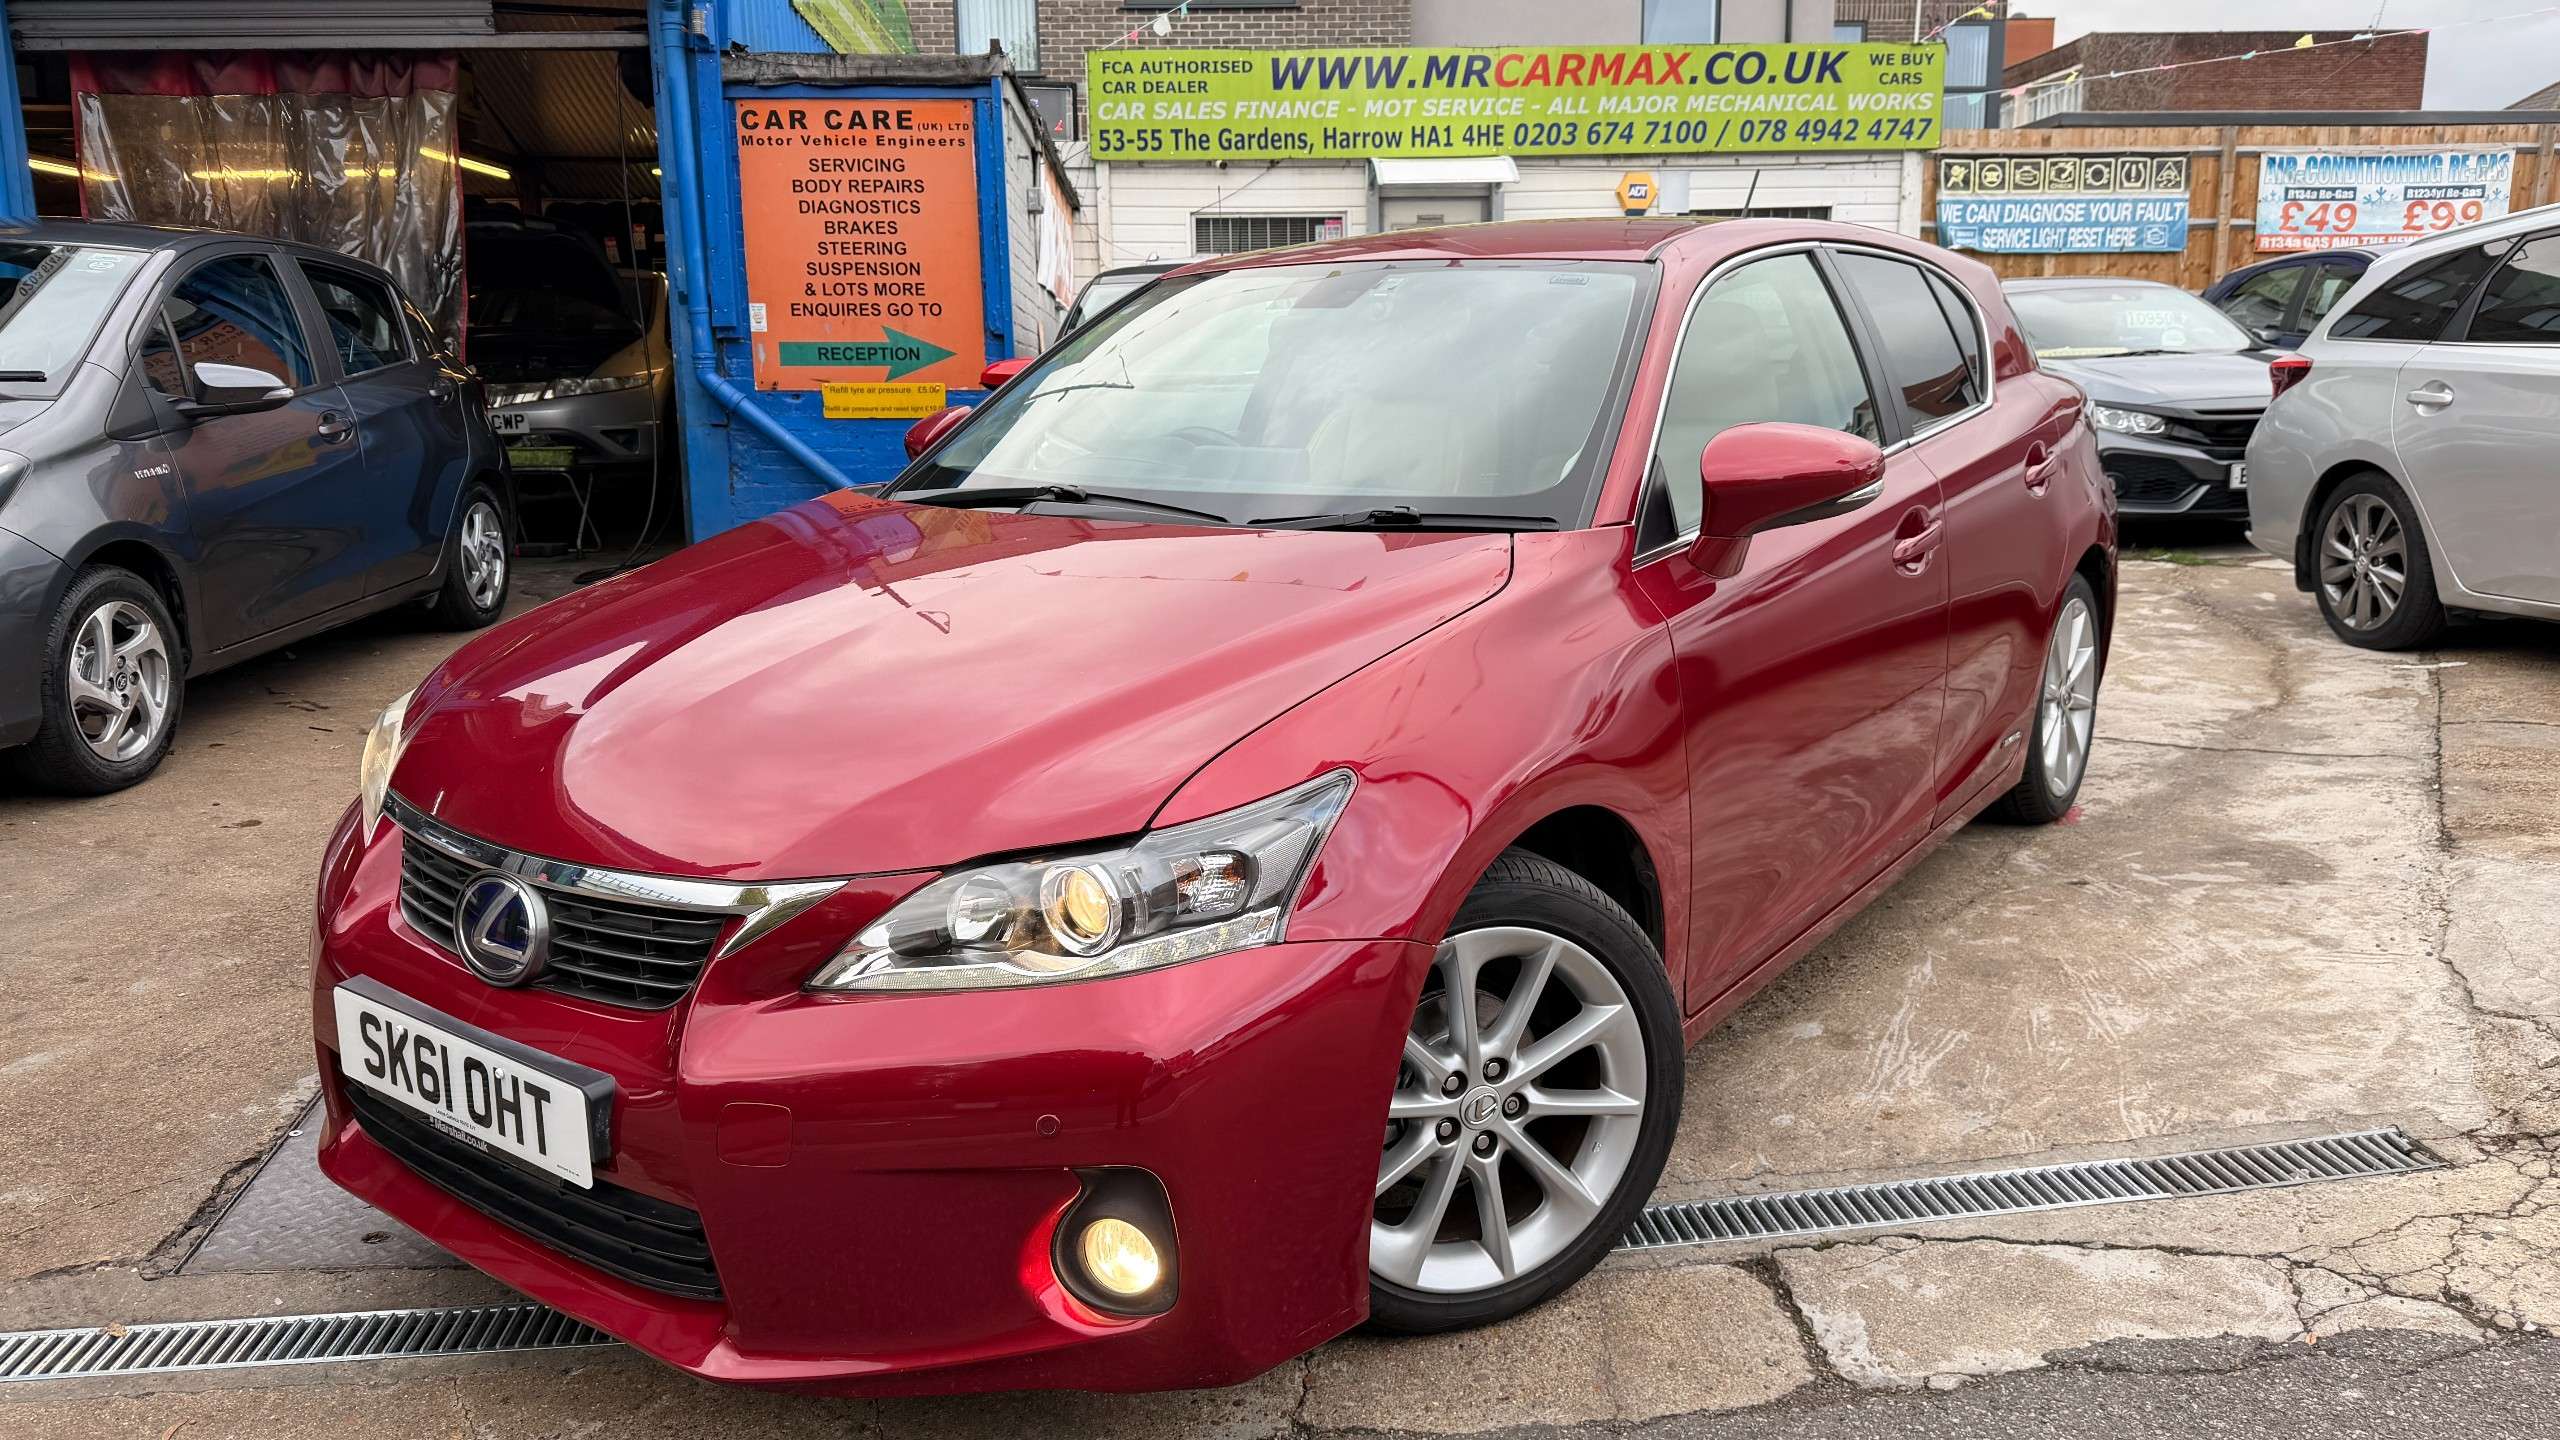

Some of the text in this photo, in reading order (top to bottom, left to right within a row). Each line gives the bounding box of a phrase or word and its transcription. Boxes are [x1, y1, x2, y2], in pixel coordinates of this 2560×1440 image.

[1870, 52, 1935, 66] WE BUY
[1102, 59, 1253, 75] FCA AUTHORISED
[1271, 50, 1849, 91] WWW.MRCARMAX.CO.UK
[1879, 72, 1922, 85] CARS
[1102, 80, 1209, 95] CAR DEALER
[1099, 101, 1146, 120] CAR
[1150, 100, 1227, 120] SALES
[1234, 99, 1340, 119] FINANCE
[1364, 98, 1416, 117] MOT
[1421, 96, 1523, 117] SERVICE
[1547, 97, 1590, 115] ALL
[1598, 95, 1678, 114] MAJOR
[1685, 93, 1839, 113] MECHANICAL
[1847, 92, 1934, 111] WORKS
[740, 109, 970, 132] CAR CARE (UK) LTD
[741, 134, 966, 149] Motor Vehicle Engineers
[1099, 117, 1933, 155] 53-55 The Gardens, Harrow HA1 4HE 0203 674 7100 / 078 4942 4747
[808, 158, 906, 173] SERVICING
[792, 179, 925, 194] BODY REPAIRS
[1628, 185, 1648, 198] ADT
[798, 200, 921, 214] DIAGNOSTICS
[1941, 202, 2187, 224] WE CAN DIAGNOSE YOUR FAULT
[2279, 201, 2358, 233] £49
[2402, 200, 2484, 232] £99
[824, 220, 898, 235] BRAKES
[1982, 229, 2031, 249] SERVICE
[2032, 228, 2067, 248] LIGHT
[2068, 227, 2104, 248] RESET
[2104, 227, 2137, 248] HERE
[2303, 236, 2331, 249] GAS
[817, 241, 907, 256] STEERING
[806, 262, 921, 276] SUSPENSION
[804, 282, 926, 297] & LOTS MORE
[791, 302, 943, 317] ENQUIRES GO TO
[817, 347, 921, 361] RECEPTION
[829, 385, 849, 394] Refill
[850, 386, 865, 396] tyre
[866, 386, 876, 394] air
[878, 387, 912, 396] pressure
[359, 1010, 551, 1157] SK61 OHT
